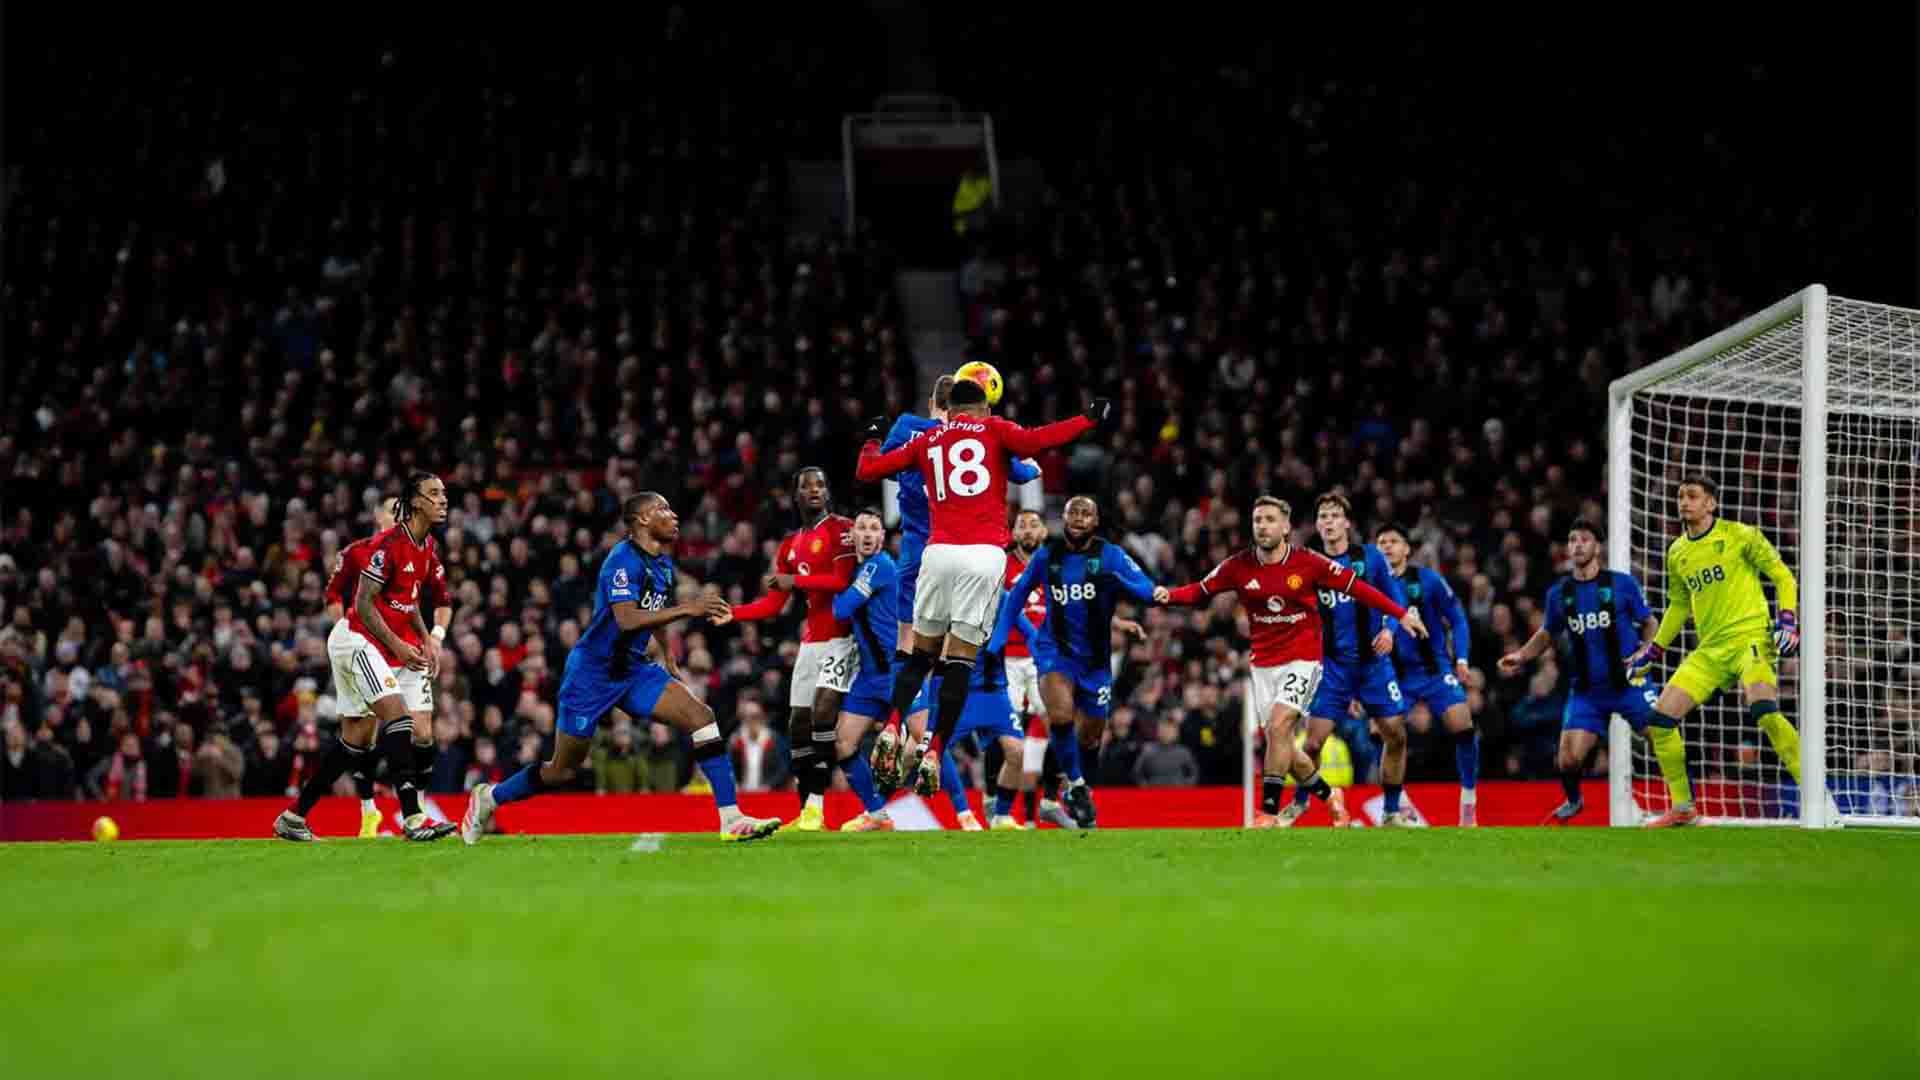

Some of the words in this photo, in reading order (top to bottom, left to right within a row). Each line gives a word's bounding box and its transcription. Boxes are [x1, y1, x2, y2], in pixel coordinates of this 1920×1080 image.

[927, 438, 992, 502] 18
[1686, 564, 1726, 593] bj88
[1051, 582, 1097, 606] bj88
[1567, 611, 1611, 635] bj88
[823, 656, 846, 677] 26
[1283, 672, 1309, 695] 23
[1387, 681, 1402, 702] 8
